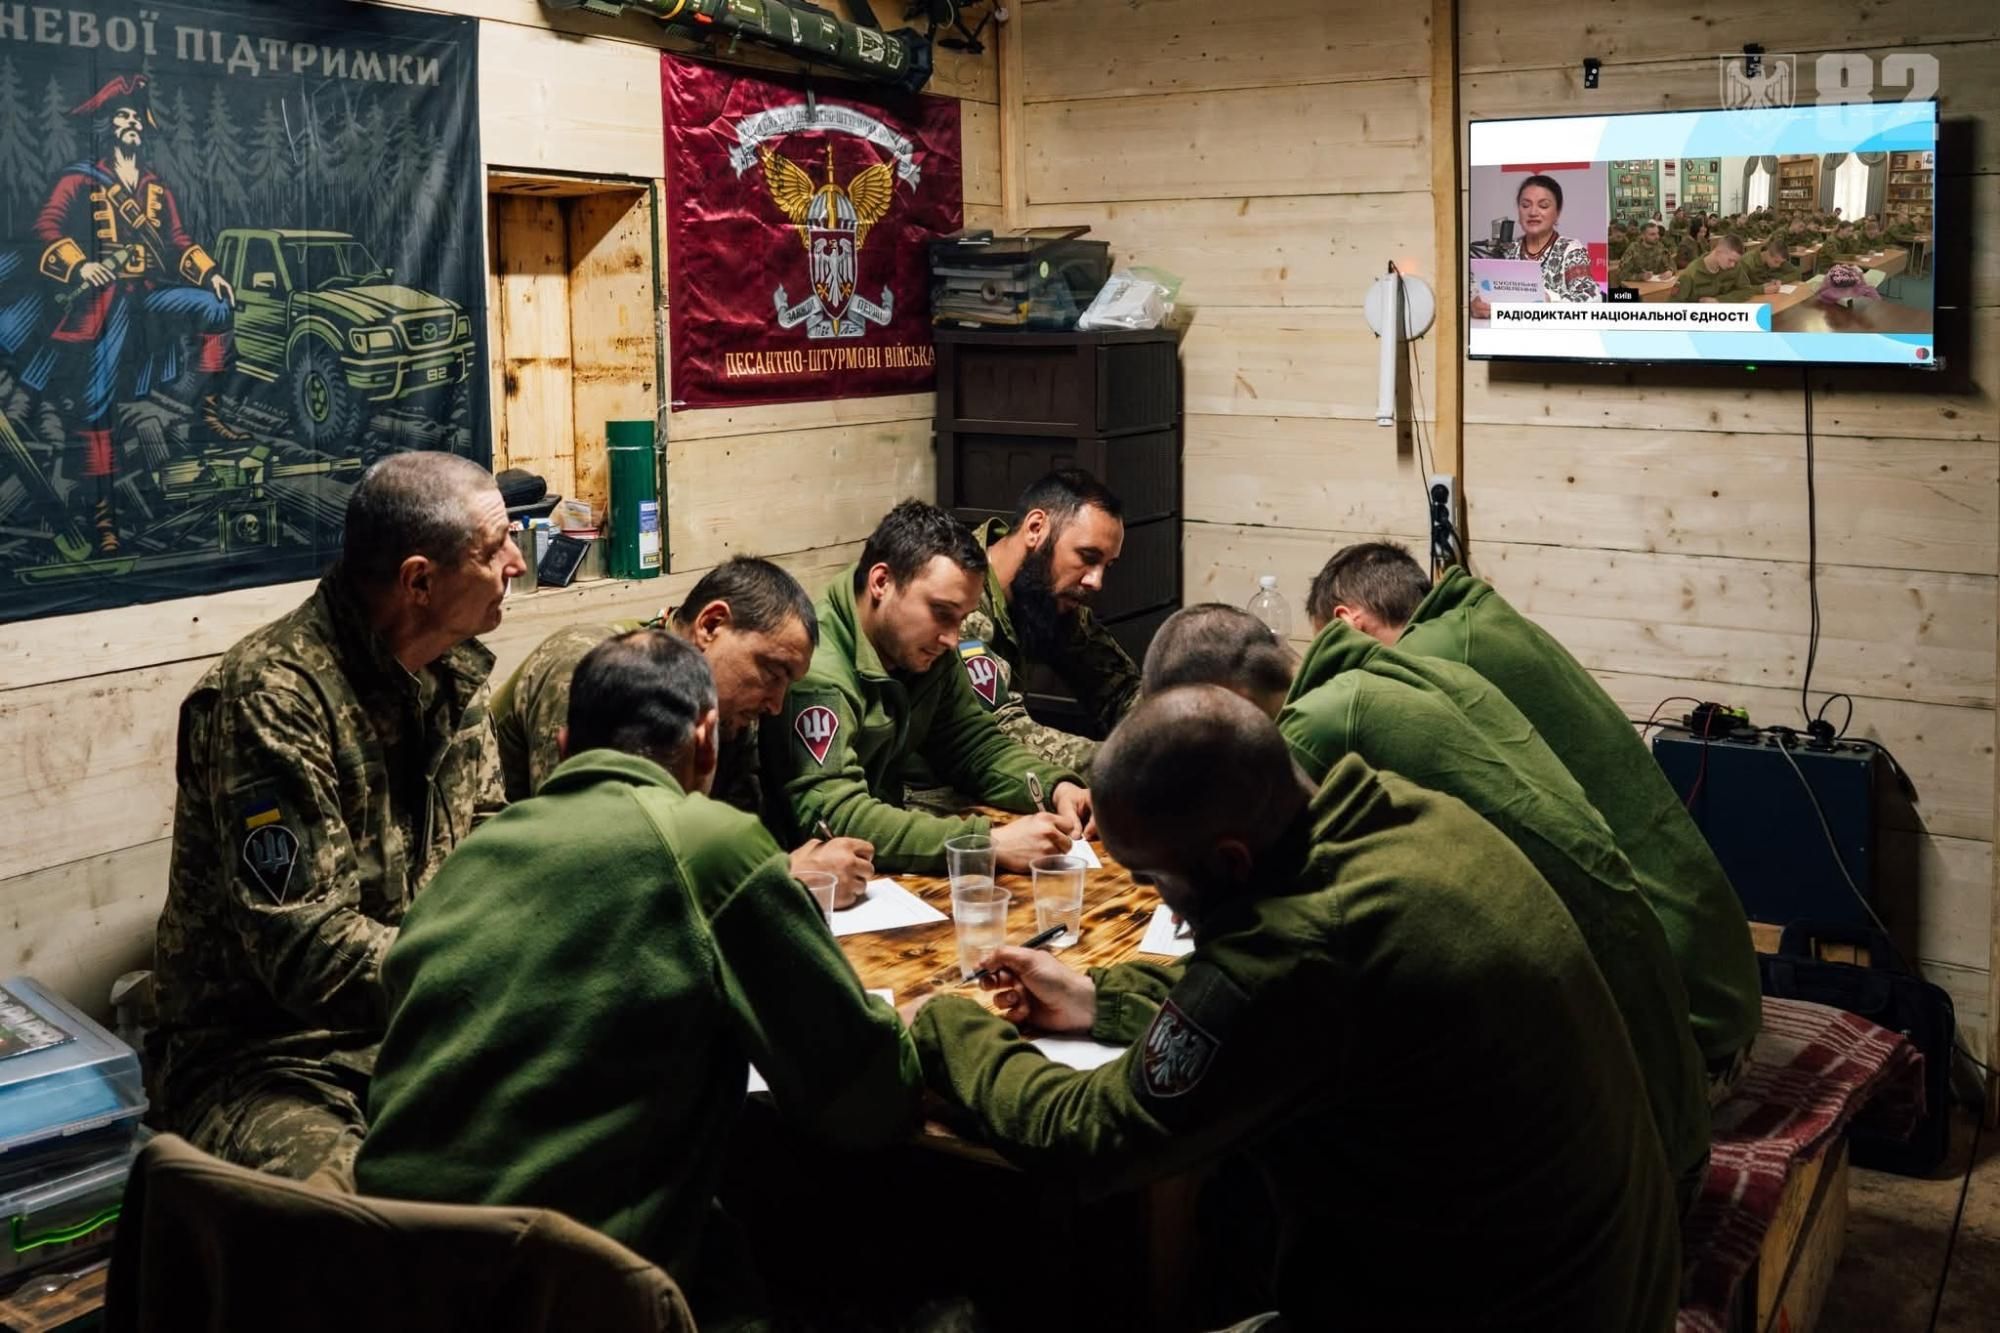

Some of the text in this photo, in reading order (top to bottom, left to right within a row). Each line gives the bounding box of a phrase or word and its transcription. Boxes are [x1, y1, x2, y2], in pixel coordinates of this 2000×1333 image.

[0, 4, 441, 87] НЕВОЇ ПІДТРИМКИ
[1614, 291, 1632, 300] КИЇВ
[1496, 309, 1748, 323] РАДІОДИКТАНТ НАЦІОНАЛЬНОЇ ЄДНОСТІ
[725, 342, 936, 378] ДЕСАНТНО-ШТУРМОВІ ВІЙСЬКА
[426, 366, 448, 382] 82
